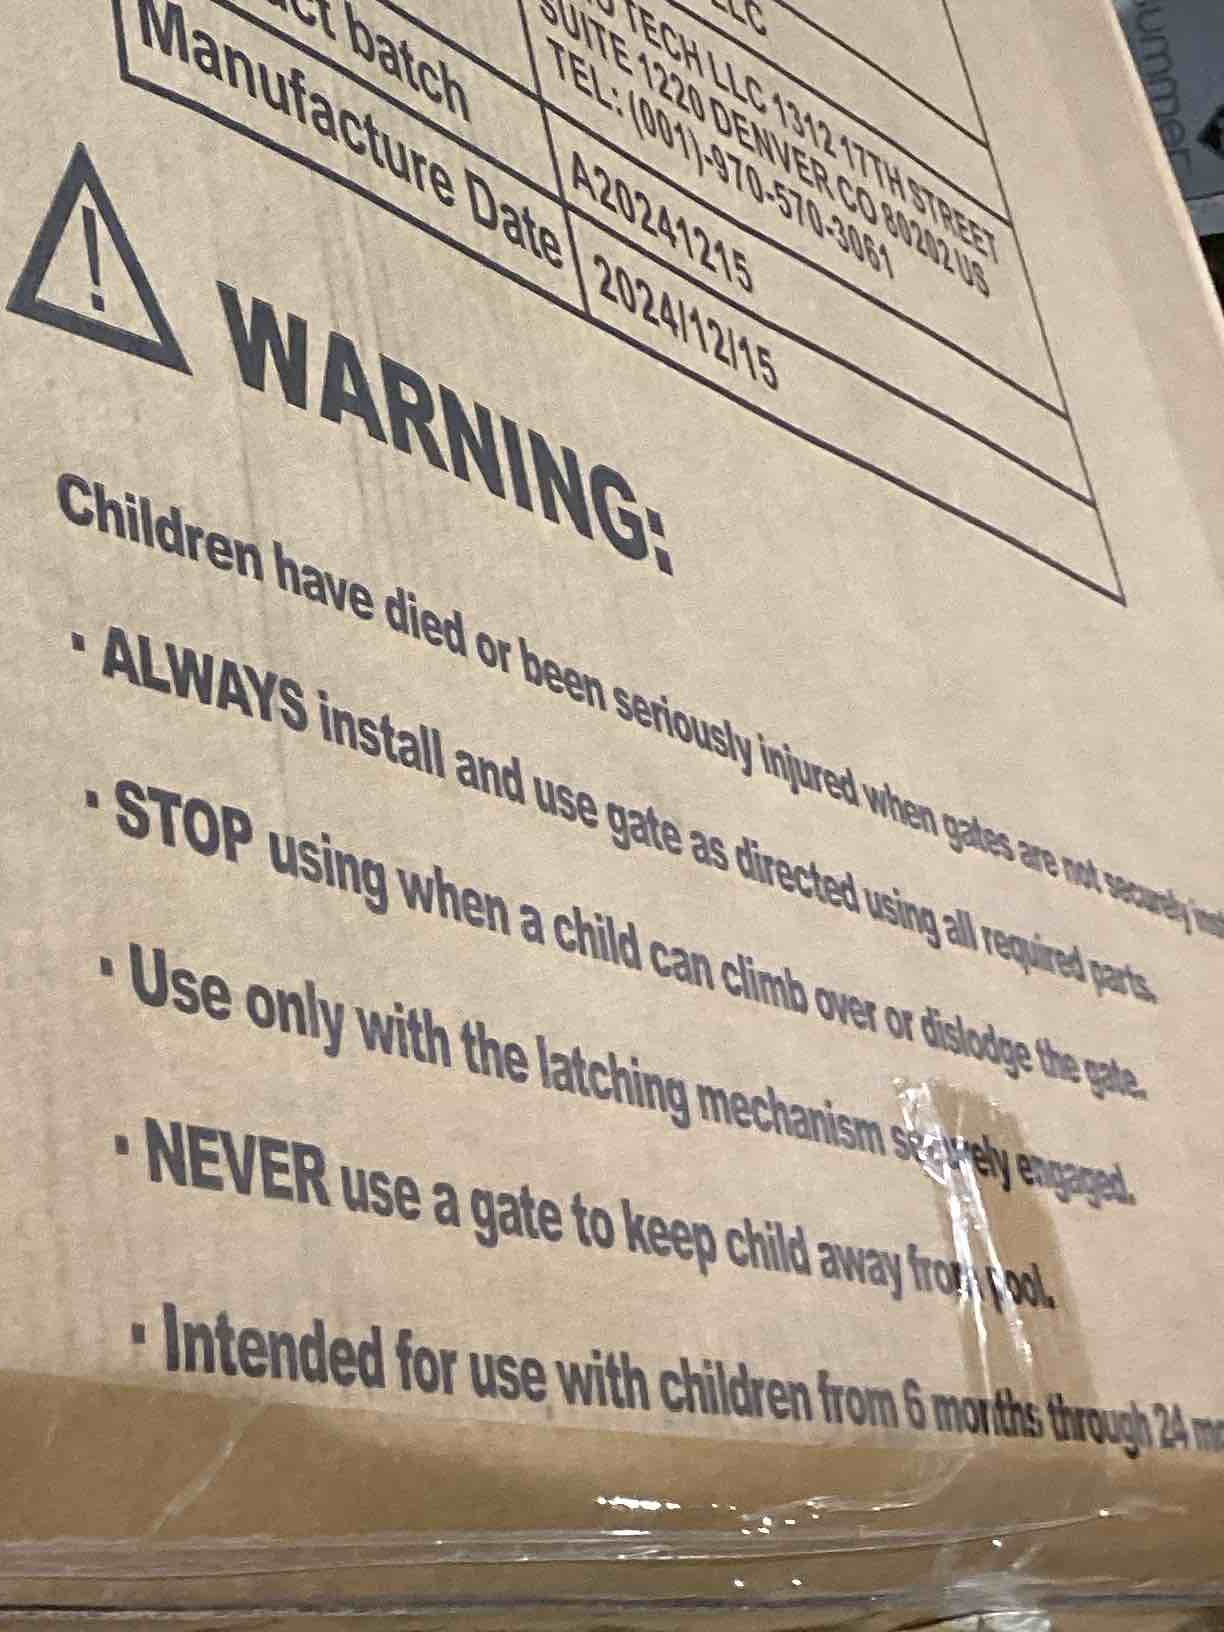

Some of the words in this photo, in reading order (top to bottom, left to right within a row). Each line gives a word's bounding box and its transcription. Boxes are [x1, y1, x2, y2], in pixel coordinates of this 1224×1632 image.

[345, 0, 470, 122] batch
[546, 36, 623, 117] TEL:
[707, 50, 767, 115] LLC
[773, 92, 837, 159] 1312
[841, 135, 906, 203] 17TH
[907, 176, 999, 265] STREET
[464, 168, 563, 269] Date
[573, 151, 753, 293] A20241215
[638, 52, 705, 122] 1220
[710, 97, 834, 201] DENVER
[837, 175, 877, 225] CO
[881, 201, 955, 275] 80202
[954, 248, 990, 299] US
[593, 254, 778, 391] 2024/12/15
[216, 279, 673, 577] WARNING:
[56, 472, 263, 581] Children
[274, 540, 374, 621] have
[385, 586, 465, 657] died
[477, 631, 512, 672] or
[519, 638, 606, 711] been
[614, 685, 752, 776] seriously
[758, 733, 859, 808] injured
[864, 782, 937, 836] when
[943, 813, 1014, 862] gates
[1017, 839, 1059, 878] are
[1062, 855, 1102, 894] not
[102, 625, 308, 733] ALWAYS
[317, 689, 445, 780] install
[455, 747, 525, 806] and
[534, 775, 597, 828] use
[607, 800, 682, 856] gate
[690, 829, 728, 872] as
[735, 836, 859, 914] directed
[863, 885, 941, 950] using
[943, 910, 977, 951] all
[981, 924, 1087, 984] required
[114, 779, 253, 863] STOP
[269, 830, 388, 916] using
[398, 864, 510, 936] when
[519, 903, 544, 946] a
[553, 905, 641, 970] child
[650, 938, 714, 991] can
[721, 953, 809, 1015] climb
[815, 985, 877, 1034] over
[886, 1006, 913, 1043] or
[920, 1006, 1033, 1080] dislodge
[1035, 1038, 1080, 1084] the
[129, 942, 232, 1020] Use
[247, 980, 345, 1058] only
[355, 1001, 451, 1069] with
[460, 1020, 529, 1084] the
[536, 1034, 688, 1129] latching
[696, 1082, 886, 1157] mechanism
[145, 1117, 330, 1207] NEVER
[340, 1163, 421, 1221] use
[433, 1182, 461, 1227] a
[470, 1185, 563, 1249] gate
[570, 1192, 615, 1250] to
[622, 1198, 716, 1275] keep
[726, 1217, 811, 1276] child
[816, 1241, 903, 1300] away
[162, 1301, 385, 1391] Intended
[396, 1328, 456, 1396] for
[470, 1347, 545, 1403] use
[556, 1348, 650, 1411] with
[660, 1353, 813, 1423] children
[816, 1370, 899, 1428] from
[903, 1377, 926, 1432] 6
[931, 1386, 1045, 1438] months
[1047, 1391, 1153, 1460] through
[1153, 1401, 1189, 1449] 24
